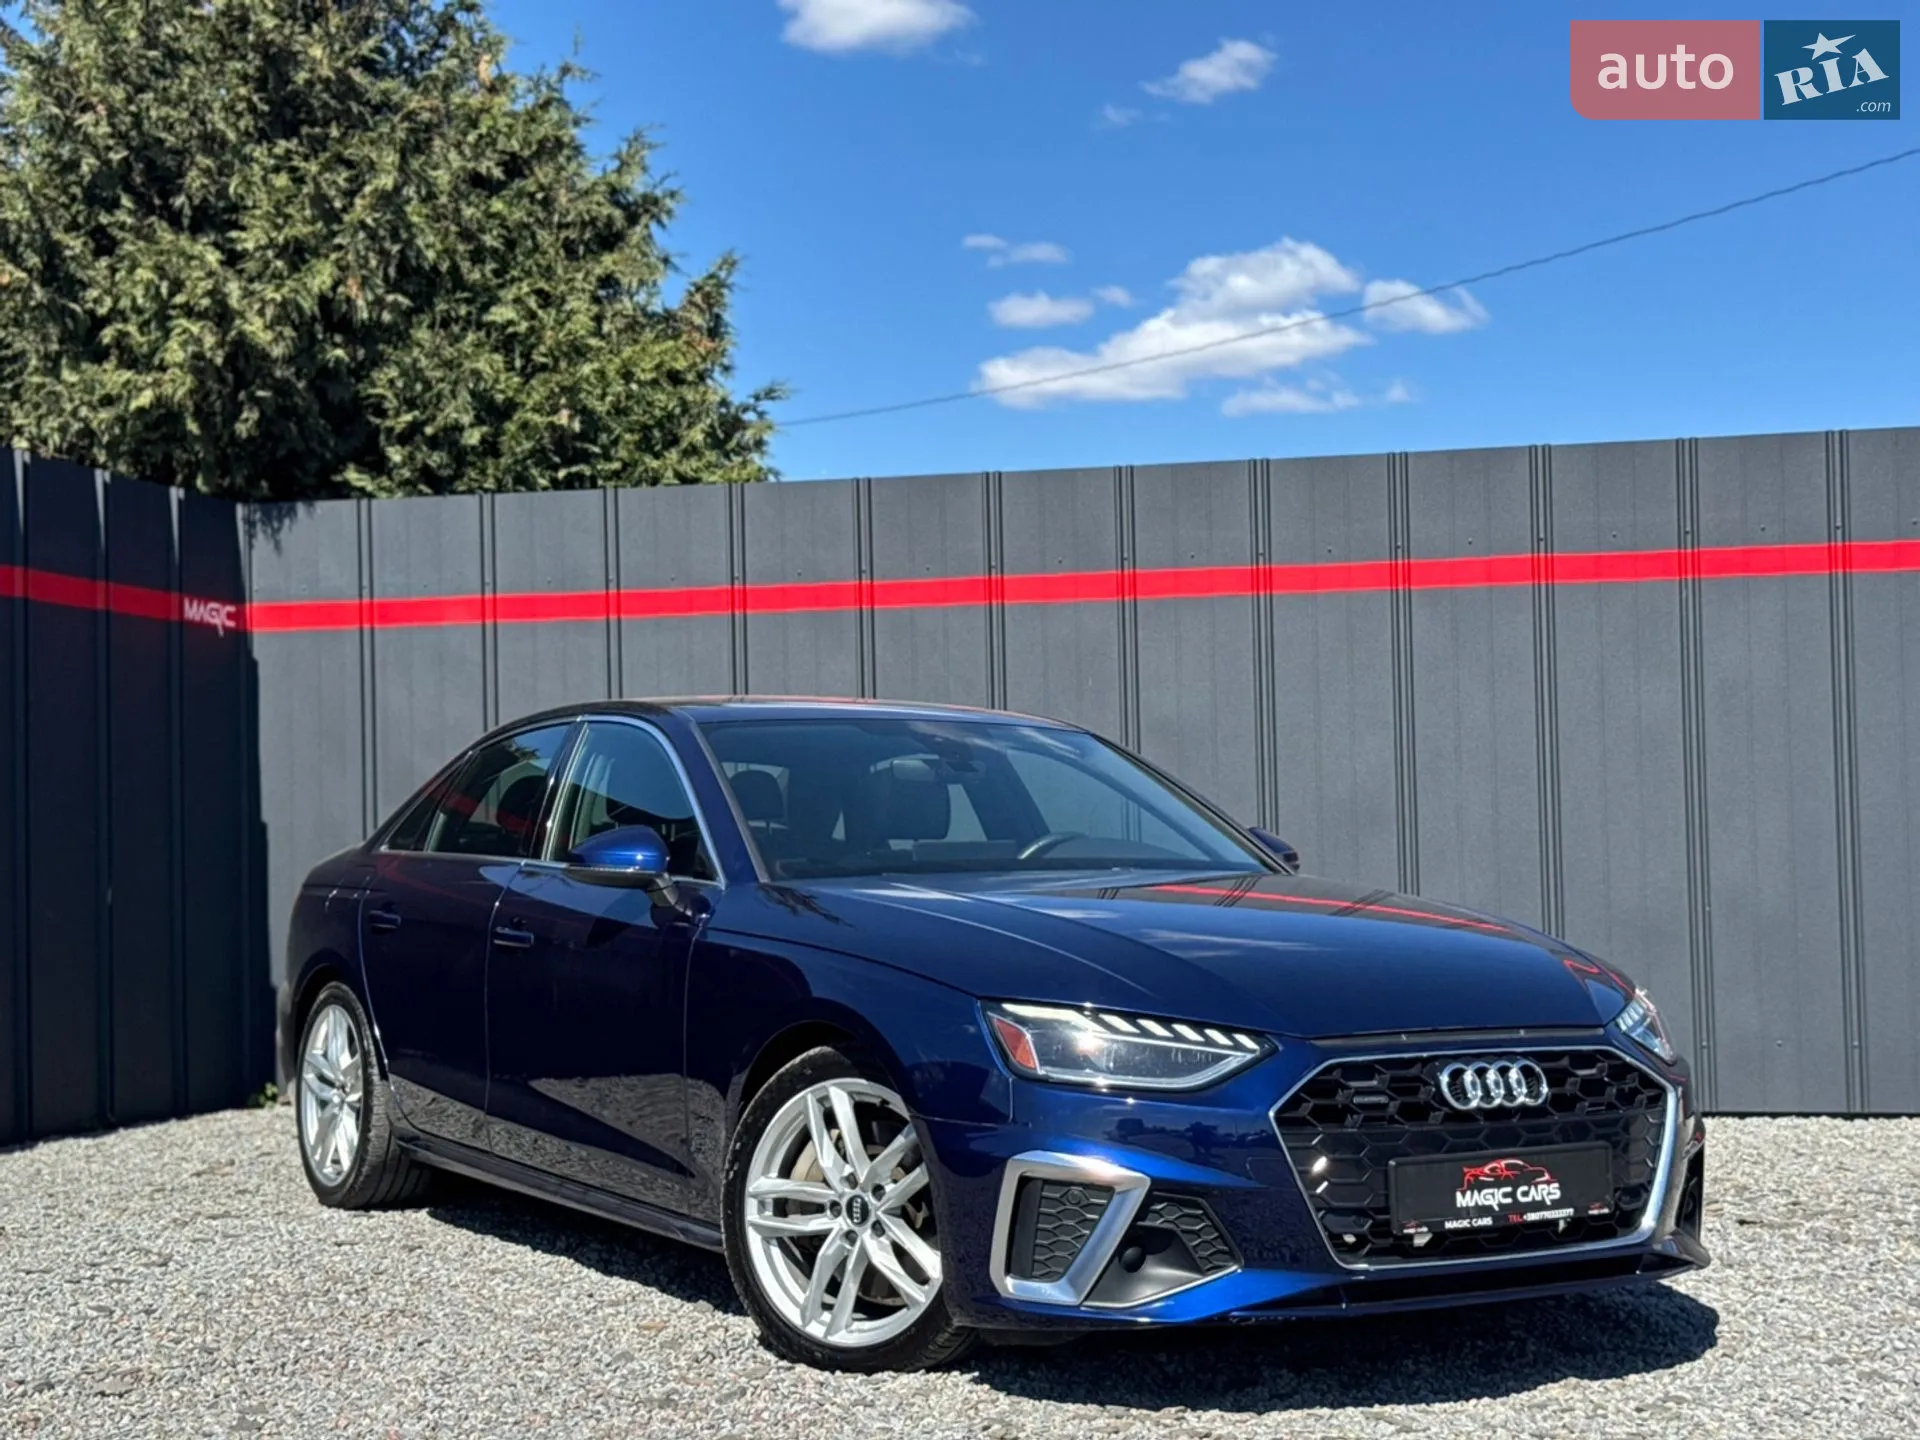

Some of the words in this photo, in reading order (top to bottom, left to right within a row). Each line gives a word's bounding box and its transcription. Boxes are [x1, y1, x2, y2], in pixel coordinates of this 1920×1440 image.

[183, 597, 237, 638] MAGIC
[1456, 1187, 1513, 1211] MAGIC
[1516, 1182, 1561, 1206] CARS
[1444, 1219, 1471, 1229] MAGIC
[1471, 1216, 1493, 1226] CARS
